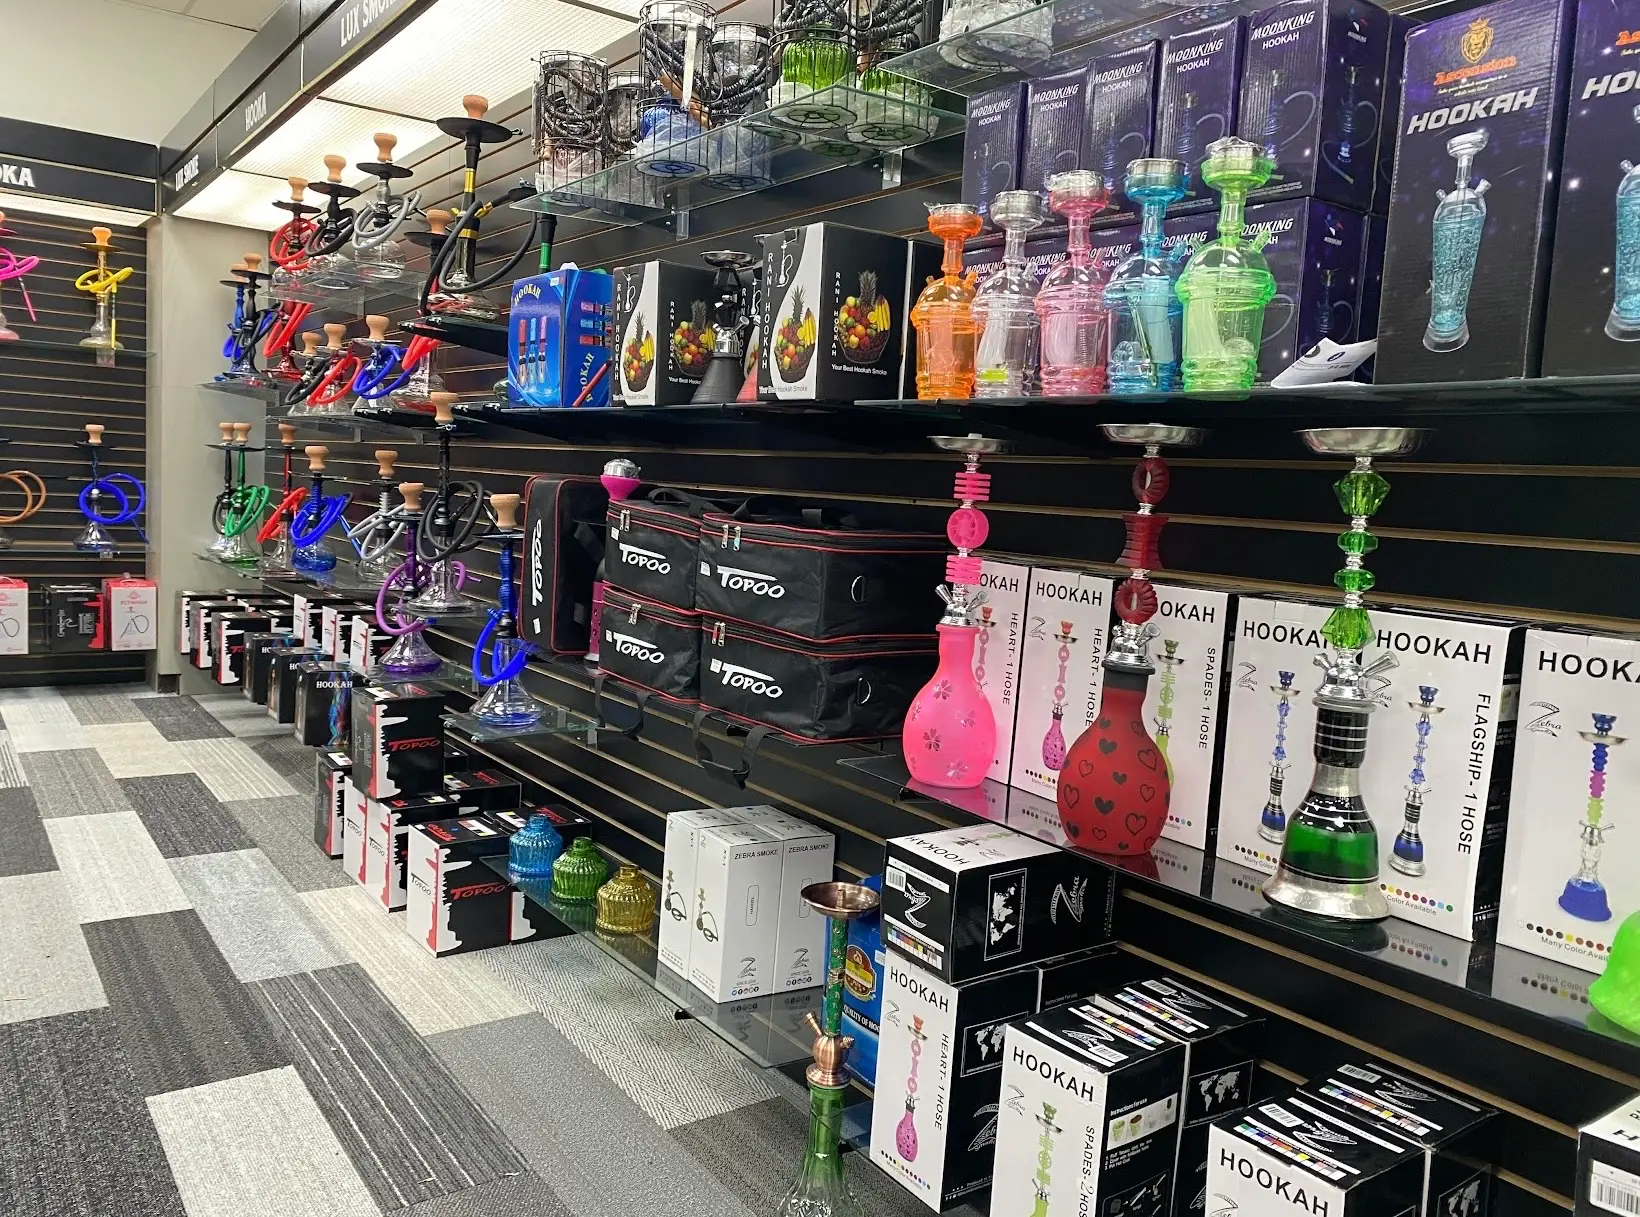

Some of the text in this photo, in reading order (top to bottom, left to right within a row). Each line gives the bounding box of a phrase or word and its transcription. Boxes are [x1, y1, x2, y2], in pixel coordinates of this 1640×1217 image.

[340, 0, 398, 47] LUX SMOK
[1251, 11, 1315, 41] MOONKING
[1166, 39, 1224, 64] MOONKING
[1262, 32, 1300, 49] HOOKAH
[1092, 62, 1144, 85] MOONKING
[1176, 58, 1210, 74] HOOKAH
[1032, 84, 1080, 103] MOONKING
[1102, 79, 1132, 94] HOOKAH
[1581, 70, 1640, 100] HO
[245, 91, 267, 131] HOOKA
[971, 99, 1011, 119] MOONKING
[1040, 100, 1068, 112] HOOKAH
[1406, 86, 1539, 135] HOOKAH
[978, 114, 1002, 127] HOOKAH
[0, 163, 36, 188] KA
[175, 154, 199, 192] LUX SMOKE
[1161, 231, 1208, 248] OONKING
[1241, 218, 1294, 236] OONKING
[513, 283, 542, 306] HOOKAH
[761, 303, 771, 369] HOOKAH
[831, 310, 839, 357] HOOKAH
[531, 519, 543, 607] TOPOO
[619, 543, 671, 574] TOPOO
[716, 565, 785, 598] TOPOO
[979, 573, 1019, 593] OKAH
[1036, 581, 1103, 607] HOOKAH
[1160, 600, 1215, 624] OKAH
[613, 632, 665, 663] TOPOO
[1376, 629, 1492, 665] HOOKAH
[1538, 650, 1640, 684] HOOK
[316, 680, 353, 689] HOOKAH
[721, 662, 783, 698] TOPOO
[1002, 671, 1013, 705] HOSE
[1085, 691, 1096, 727] HOSE
[389, 736, 441, 752] TOPOO
[1199, 715, 1210, 749] HOSE
[1457, 806, 1476, 855] HOSE
[369, 837, 385, 857] TOPOO
[734, 849, 778, 860] ZEBRA SMOKE
[788, 843, 830, 854] ZEBRA SMOKE
[905, 836, 971, 866] HOOKAH
[411, 873, 432, 896] TOPOO
[450, 882, 509, 901] TOPOO
[1386, 894, 1437, 916] Color Available
[1541, 935, 1563, 950] Many
[1564, 943, 1587, 956] Color
[890, 966, 949, 1013] HOOKAH
[843, 1004, 862, 1022] QUALITY
[861, 1018, 869, 1026] OF
[1013, 1046, 1094, 1102] HOOKAH
[934, 1095, 948, 1131] HOSE
[1220, 1148, 1329, 1217] HOOKAH
